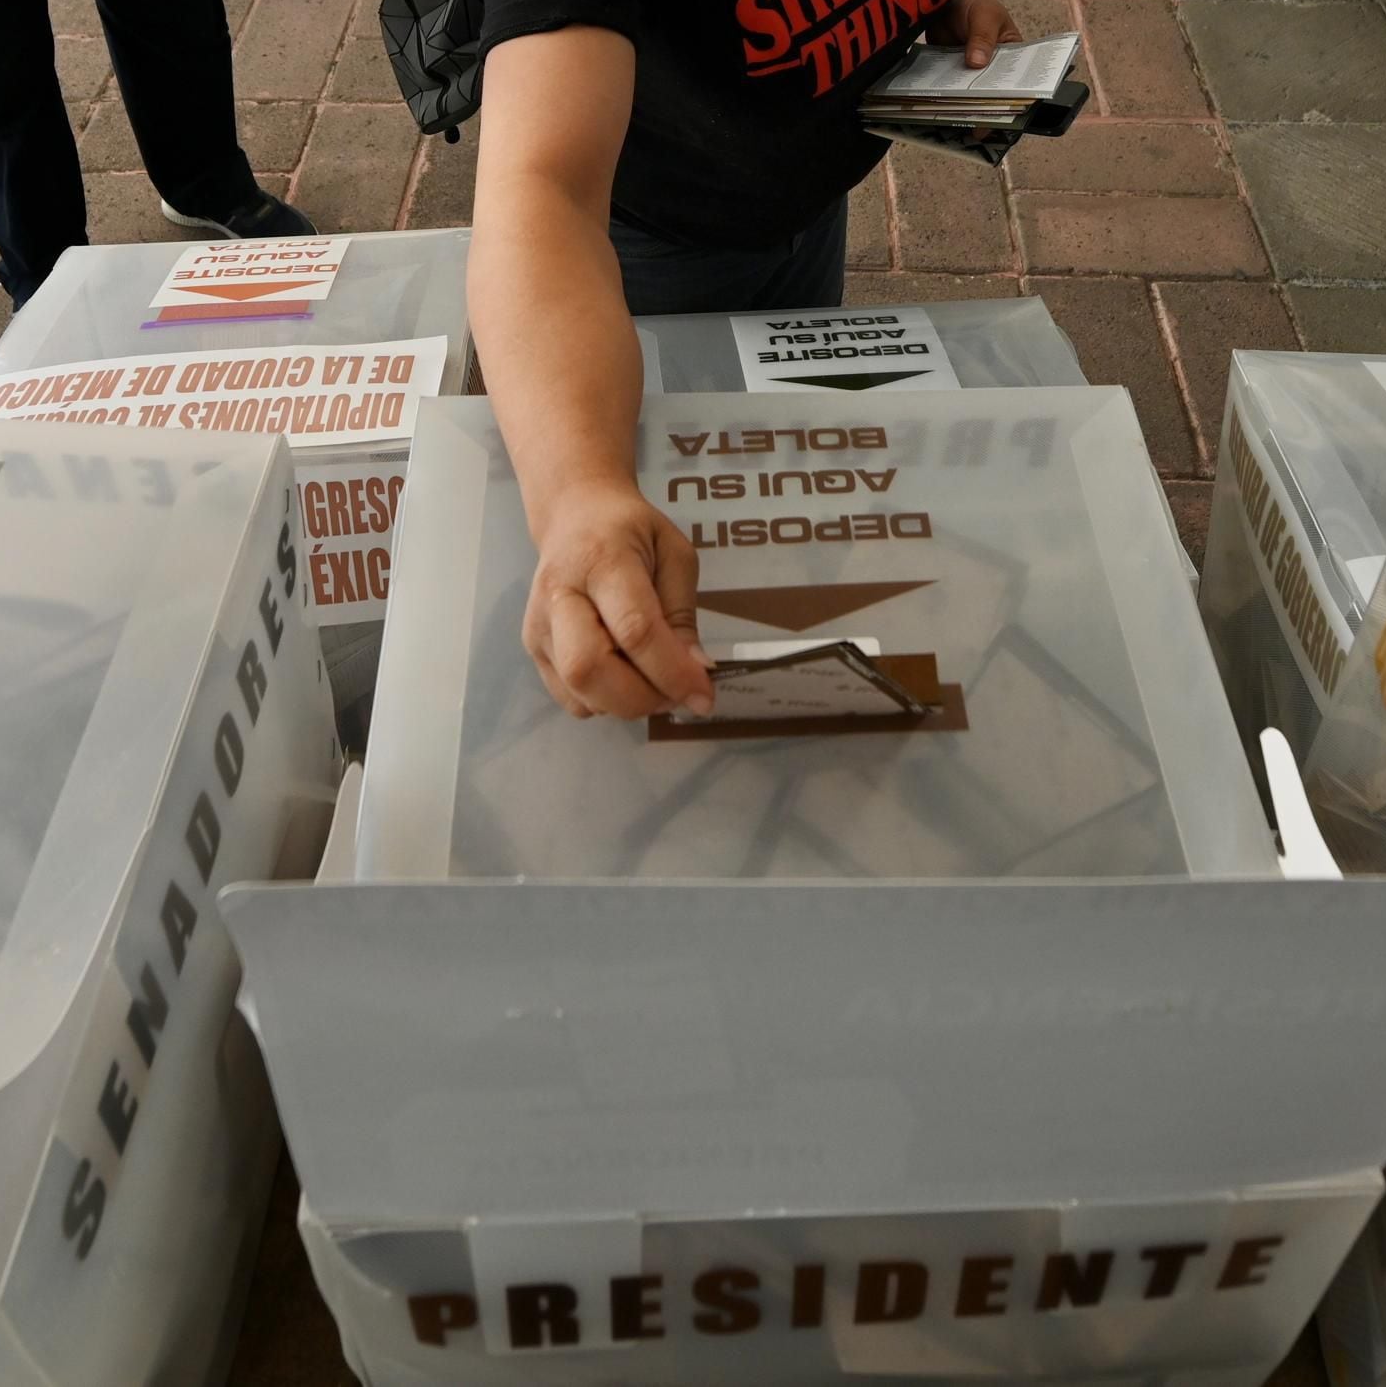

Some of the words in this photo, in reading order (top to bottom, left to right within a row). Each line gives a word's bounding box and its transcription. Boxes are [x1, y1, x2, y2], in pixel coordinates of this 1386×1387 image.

[175, 264, 338, 280] DEPOSITE
[194, 252, 239, 265] SU
[243, 250, 328, 266] AQUÍ
[766, 315, 901, 331] BOLETA
[769, 331, 810, 346] SU
[813, 328, 907, 349] AQUÍ
[372, 354, 416, 384] DE
[758, 343, 931, 364] DEPOSITE
[127, 364, 177, 397] DE
[176, 356, 314, 393] CIUDAD
[320, 355, 360, 384] LA
[178, 392, 406, 435] DIPUTACIONES
[668, 425, 889, 458] BOLETA
[667, 472, 746, 503] SU
[758, 468, 898, 500] AQUI
[691, 512, 933, 549] DEPOSIT
[309, 543, 391, 606] ÉXIC
[1258, 497, 1287, 571] DE
[1273, 535, 1347, 699] GOBIERNO
[61, 520, 297, 1262] SENADORES
[406, 1234, 1286, 1351] PRESIDENTE
